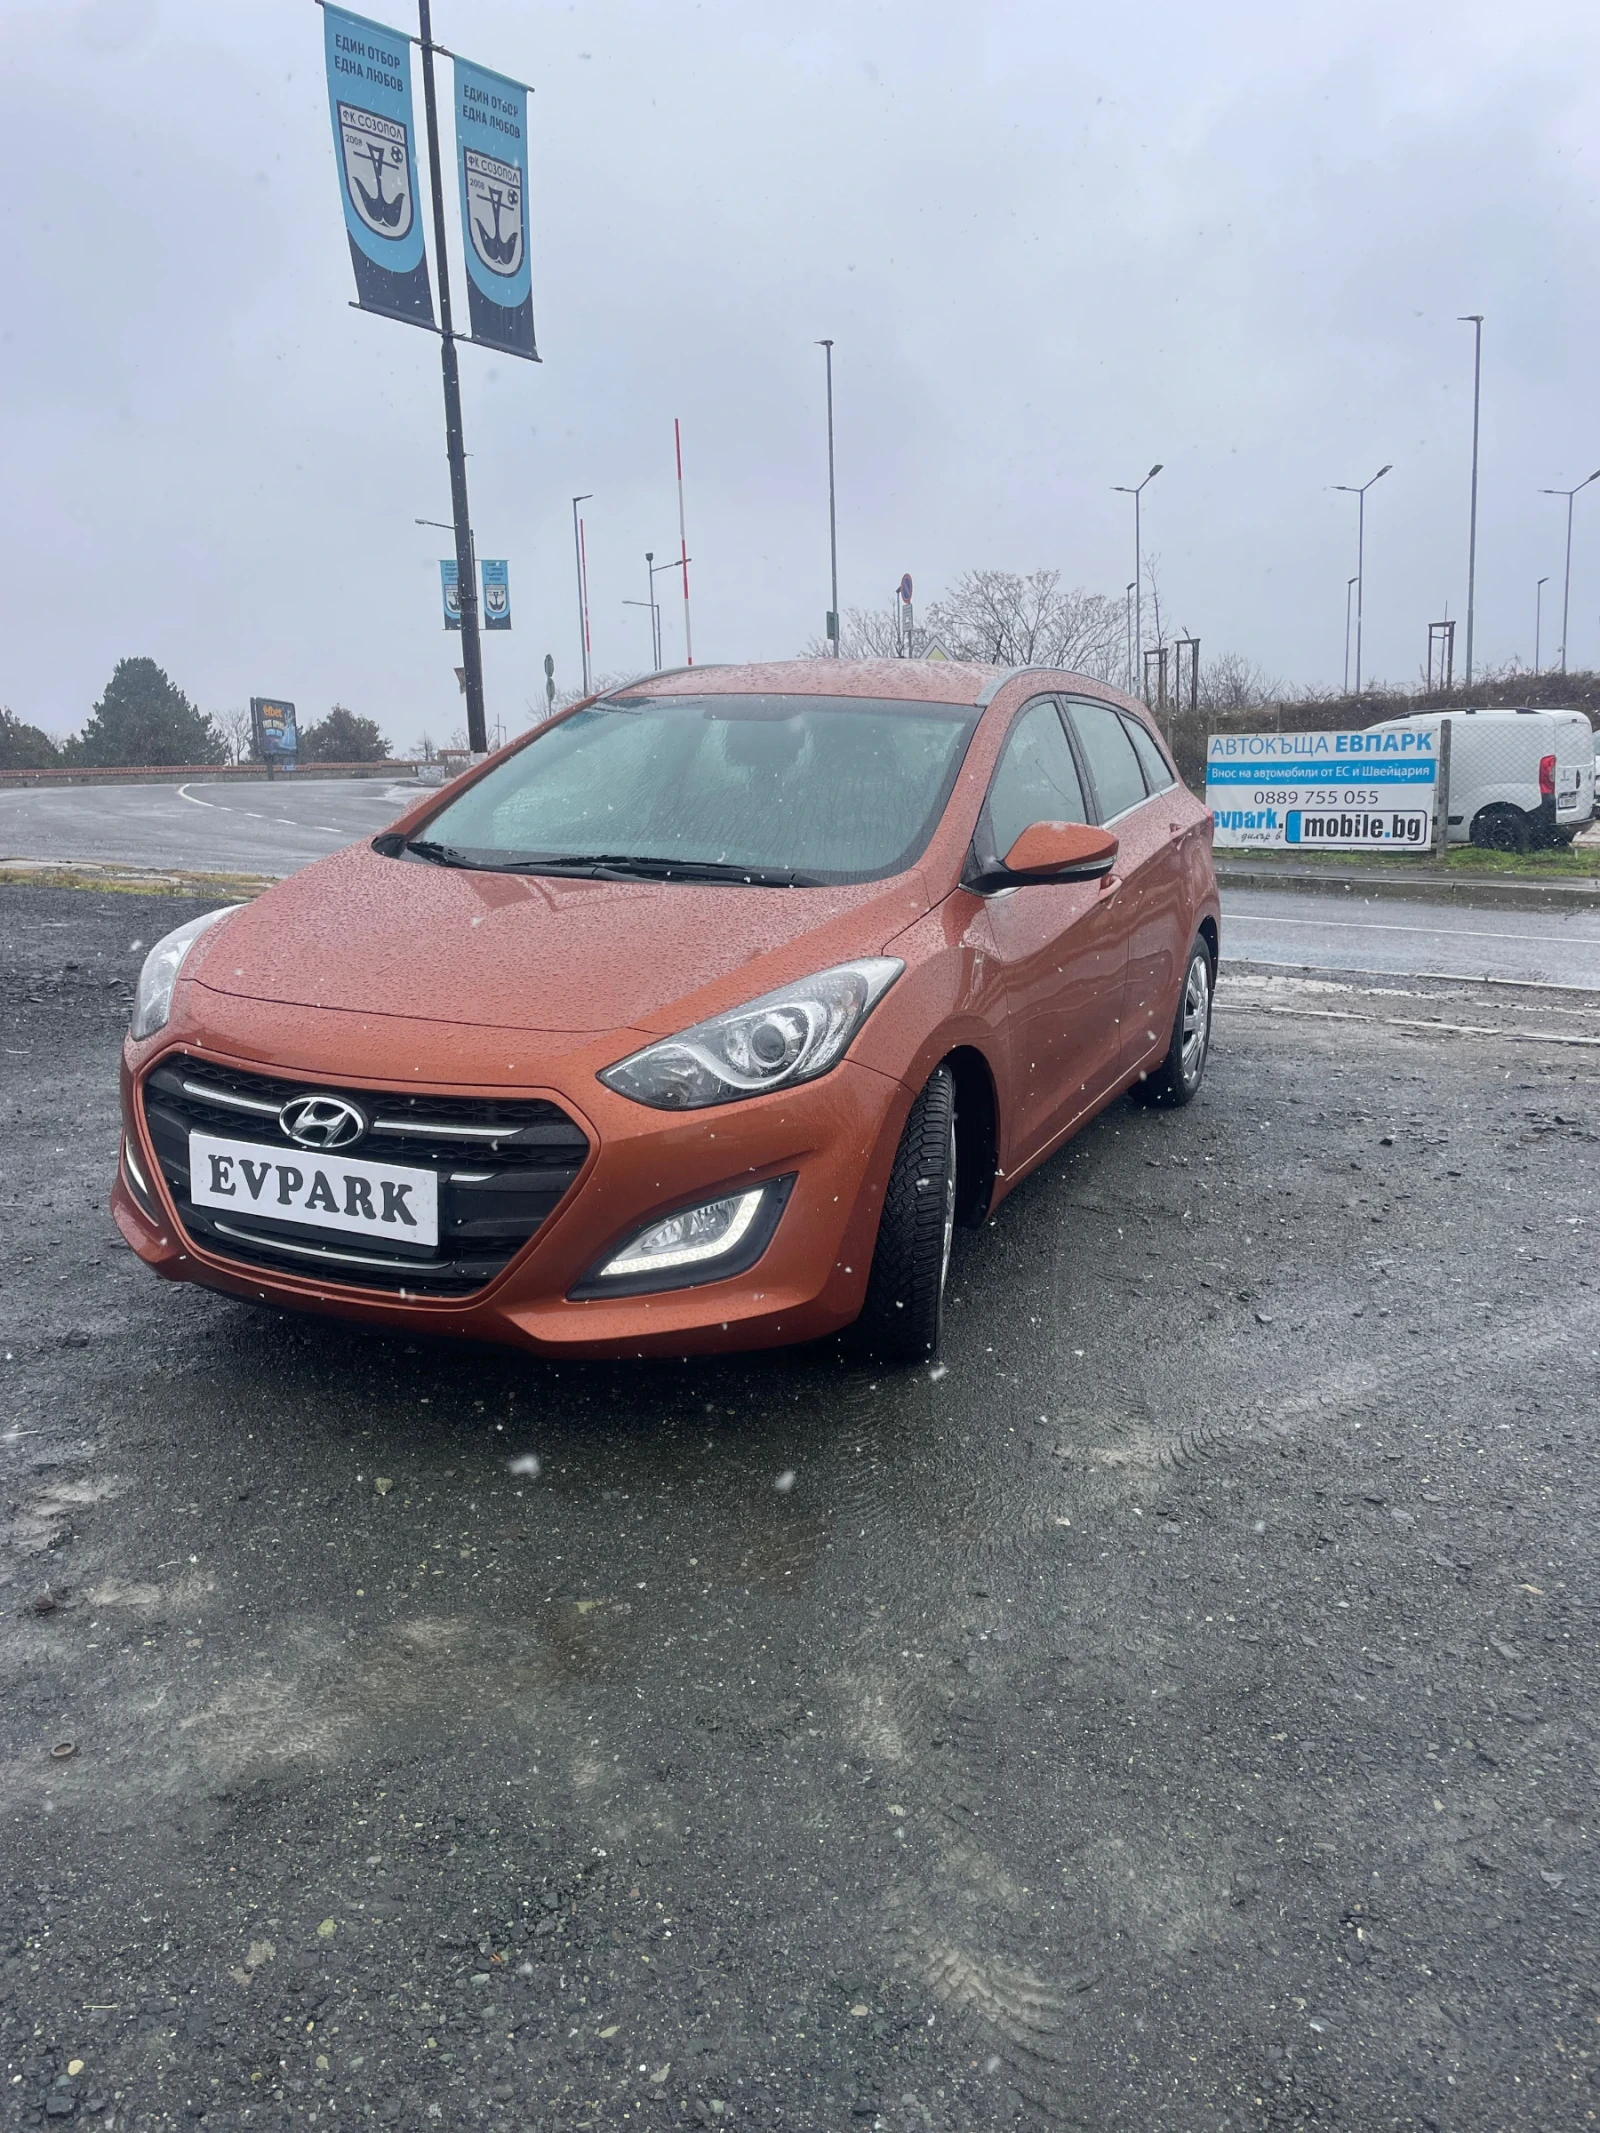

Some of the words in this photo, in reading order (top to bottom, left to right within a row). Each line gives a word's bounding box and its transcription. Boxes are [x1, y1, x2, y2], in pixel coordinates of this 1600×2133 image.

[335, 34, 365, 56] ЕДИН
[367, 45, 401, 70] ОТБОР
[334, 55, 364, 78] ЕДНА
[366, 66, 404, 93] ЛЮБОВ
[463, 84, 489, 106] ЕДИН
[491, 95, 519, 118] ОТБОР
[342, 110, 356, 124] ФК
[357, 114, 403, 140] СОЗОПОЛ
[462, 104, 487, 126] ЕДНА
[489, 115, 521, 139] ЛЮБОВ
[345, 134, 363, 146] 2008
[468, 155, 480, 169] ФК
[481, 159, 519, 183] СОЗОПОЛ
[469, 178, 485, 190] 2008
[1211, 736, 1329, 757] АВТОКЪЩА
[1335, 732, 1433, 753] ЕВПАРК
[1212, 767, 1237, 778] Внос
[1239, 768, 1251, 778] на
[1253, 767, 1318, 778] автомобили
[1320, 768, 1333, 777] от
[1335, 766, 1350, 777] ЕС
[1352, 768, 1360, 776] и
[1362, 765, 1430, 778] Швейцария
[1254, 791, 1298, 804] 0889
[1304, 791, 1338, 804] 755
[1344, 791, 1379, 804] 055
[1304, 814, 1421, 842] mobile.bg
[208, 1154, 418, 1226] EVPARK
